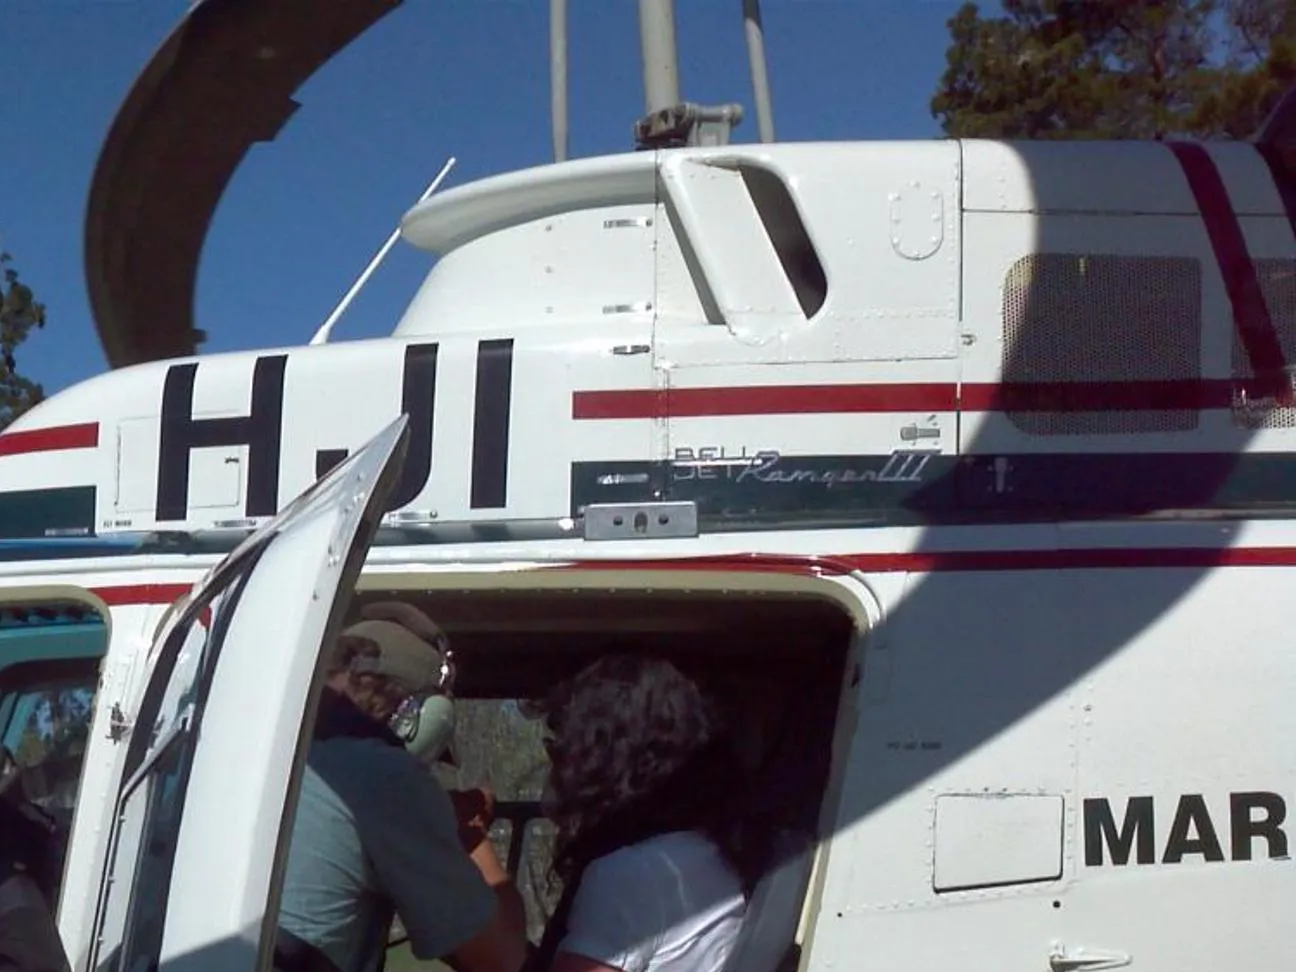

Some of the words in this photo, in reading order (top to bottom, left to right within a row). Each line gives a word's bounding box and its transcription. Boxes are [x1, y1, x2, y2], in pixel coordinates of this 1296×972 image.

[156, 339, 514, 522] HJI
[675, 445, 758, 462] BELL
[735, 450, 879, 489] Ranger
[1083, 791, 1289, 867] MAR
